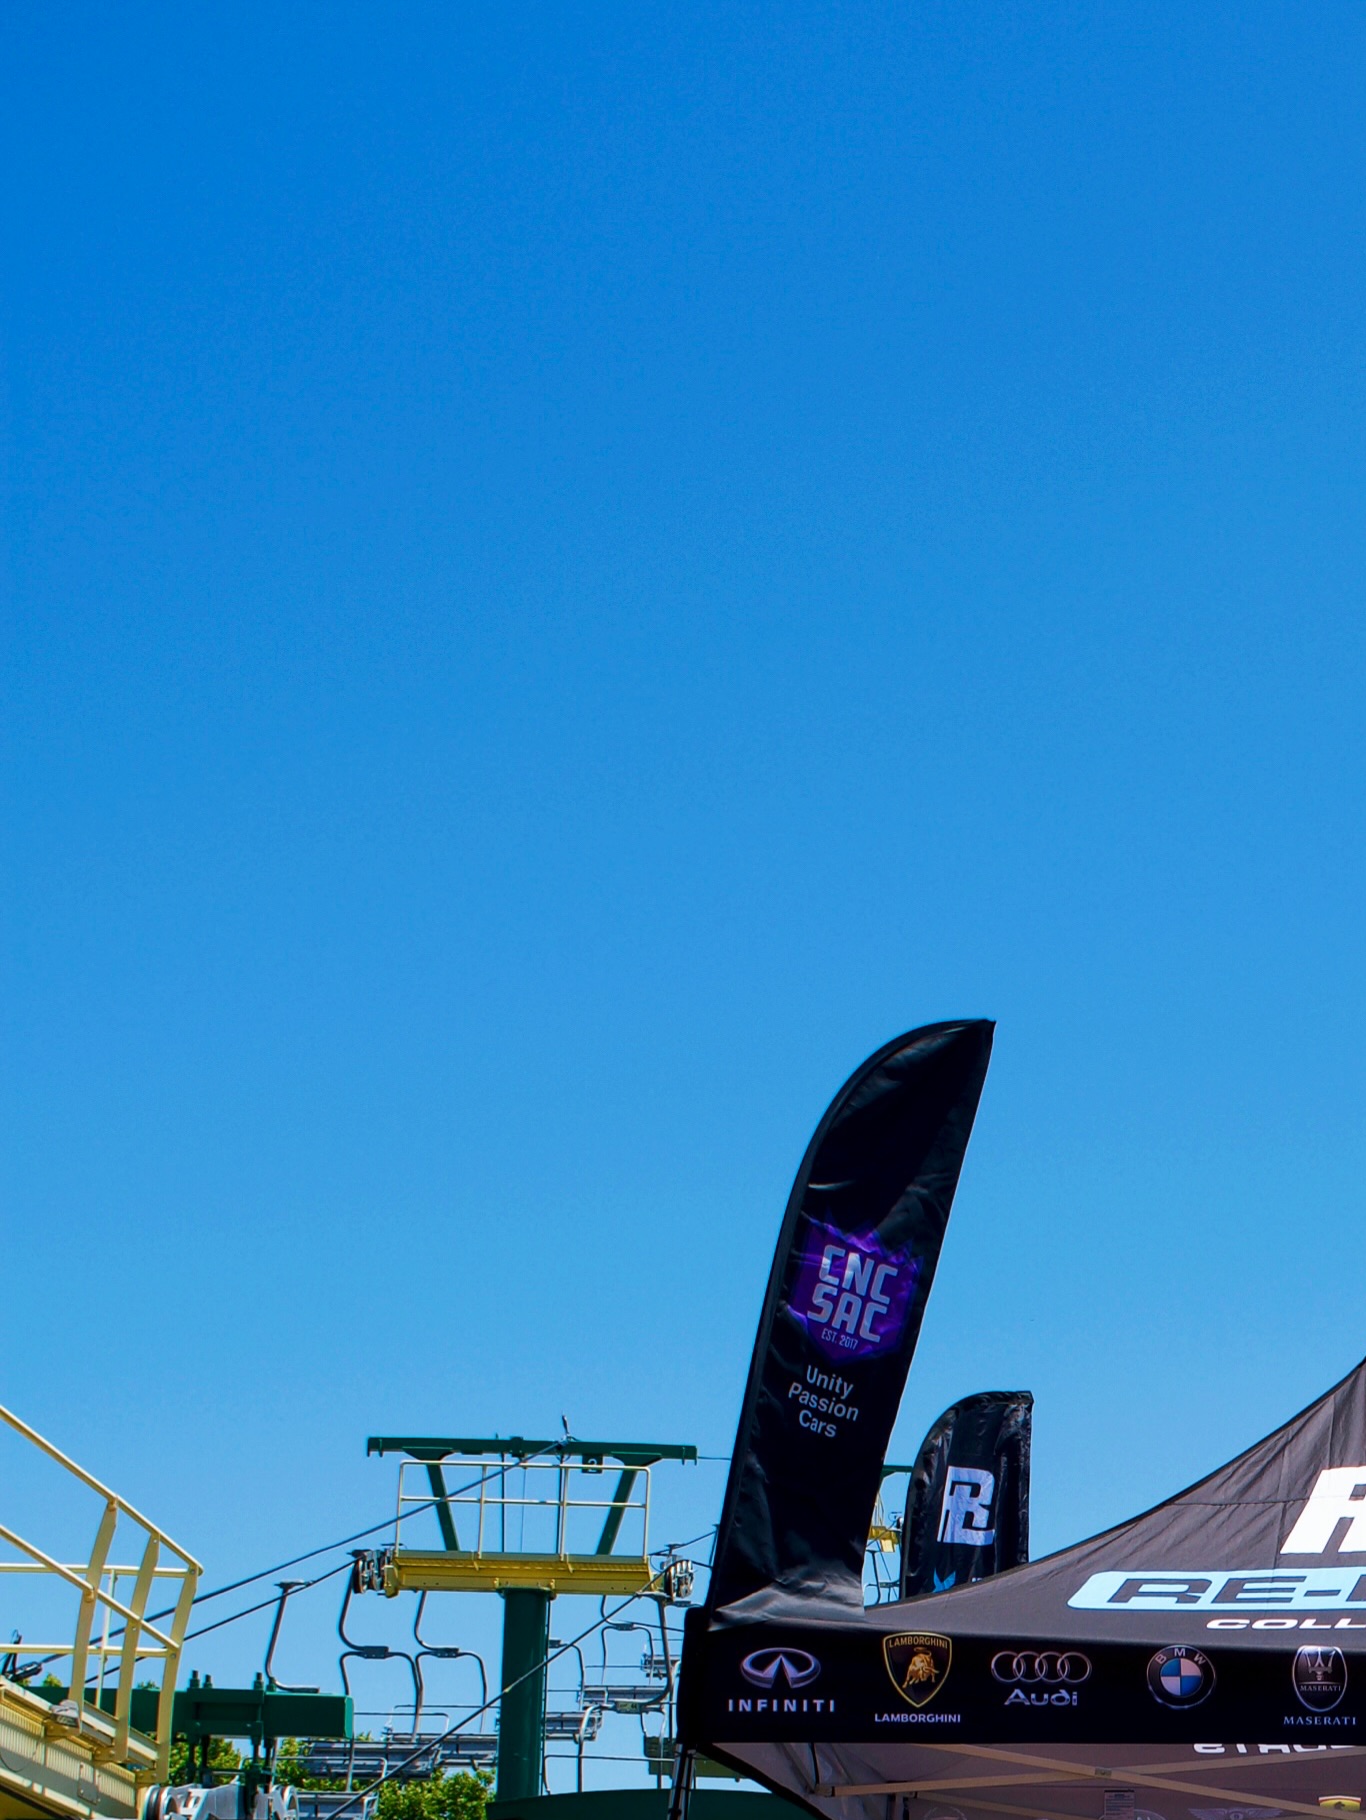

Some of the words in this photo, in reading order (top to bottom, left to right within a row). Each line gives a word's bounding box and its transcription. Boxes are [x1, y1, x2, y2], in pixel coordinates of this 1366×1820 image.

[819, 1244, 898, 1305] CNC
[806, 1282, 888, 1343] SAC
[821, 1327, 837, 1344] EST.
[838, 1335, 859, 1350] 2017
[806, 1364, 855, 1400] Unity
[788, 1381, 860, 1422] Passion
[798, 1408, 838, 1438] Cars
[887, 1635, 949, 1650] LAMBORGHINI
[1004, 1687, 1079, 1707] Audi
[1299, 1683, 1342, 1692] MASERATI
[727, 1698, 836, 1714] INFINITI
[874, 1712, 962, 1724] LAMBORGHINI
[1283, 1715, 1357, 1726] MASERATI
